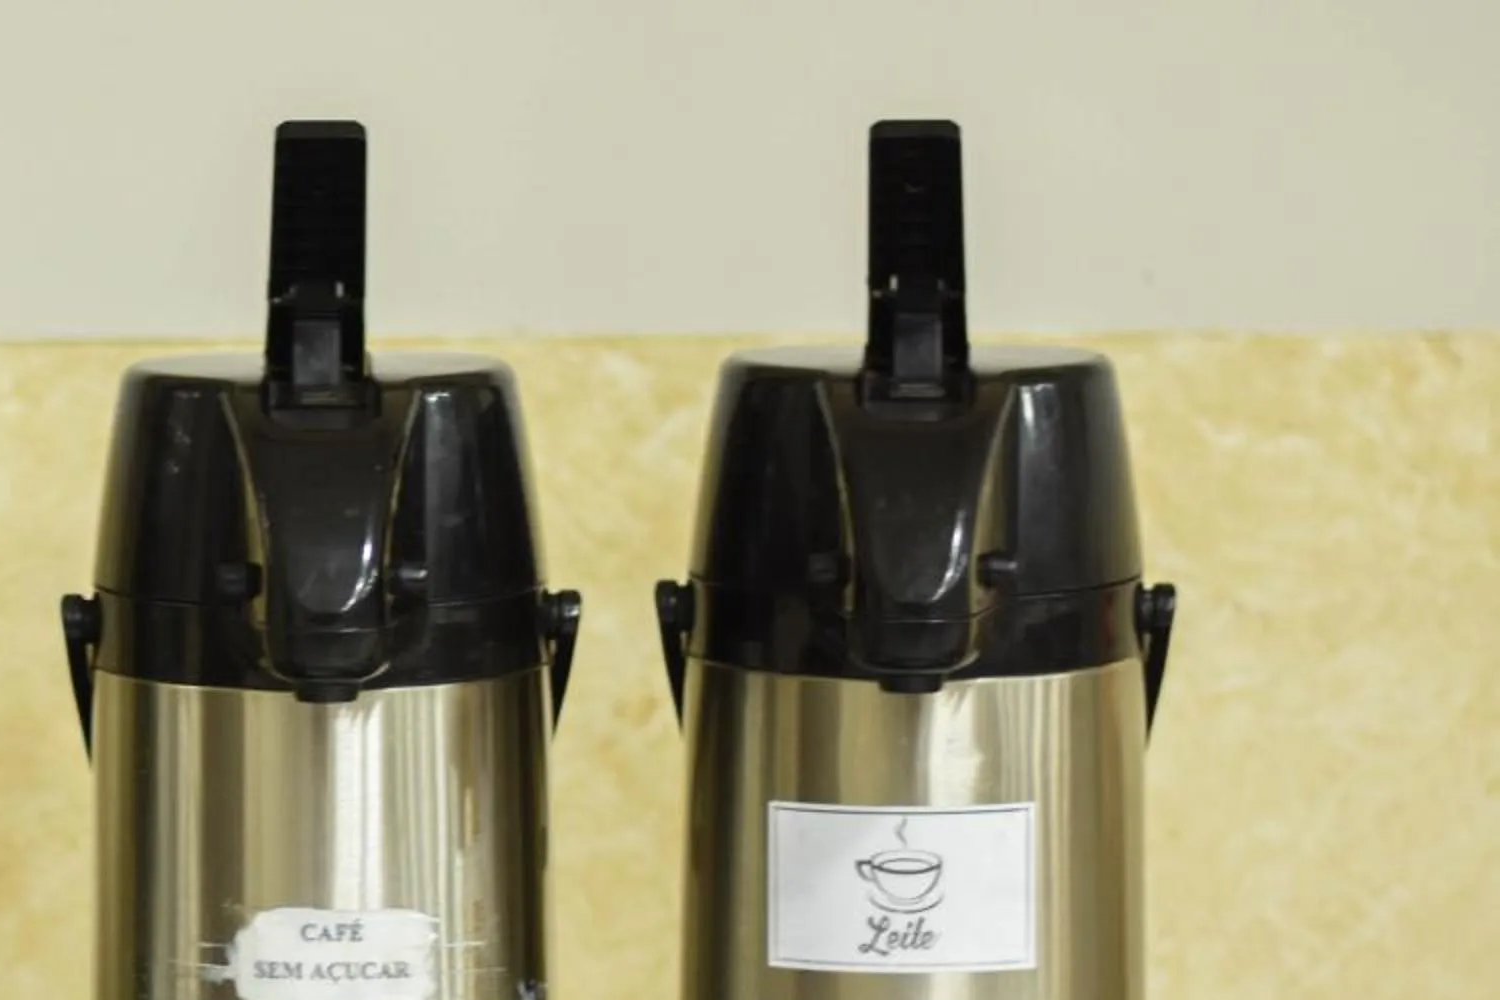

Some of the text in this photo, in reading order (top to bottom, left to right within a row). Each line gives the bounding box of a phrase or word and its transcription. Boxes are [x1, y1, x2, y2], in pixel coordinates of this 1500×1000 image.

[300, 919, 363, 942] CAFÉ
[857, 916, 940, 957] Leite
[253, 960, 303, 980] SEM
